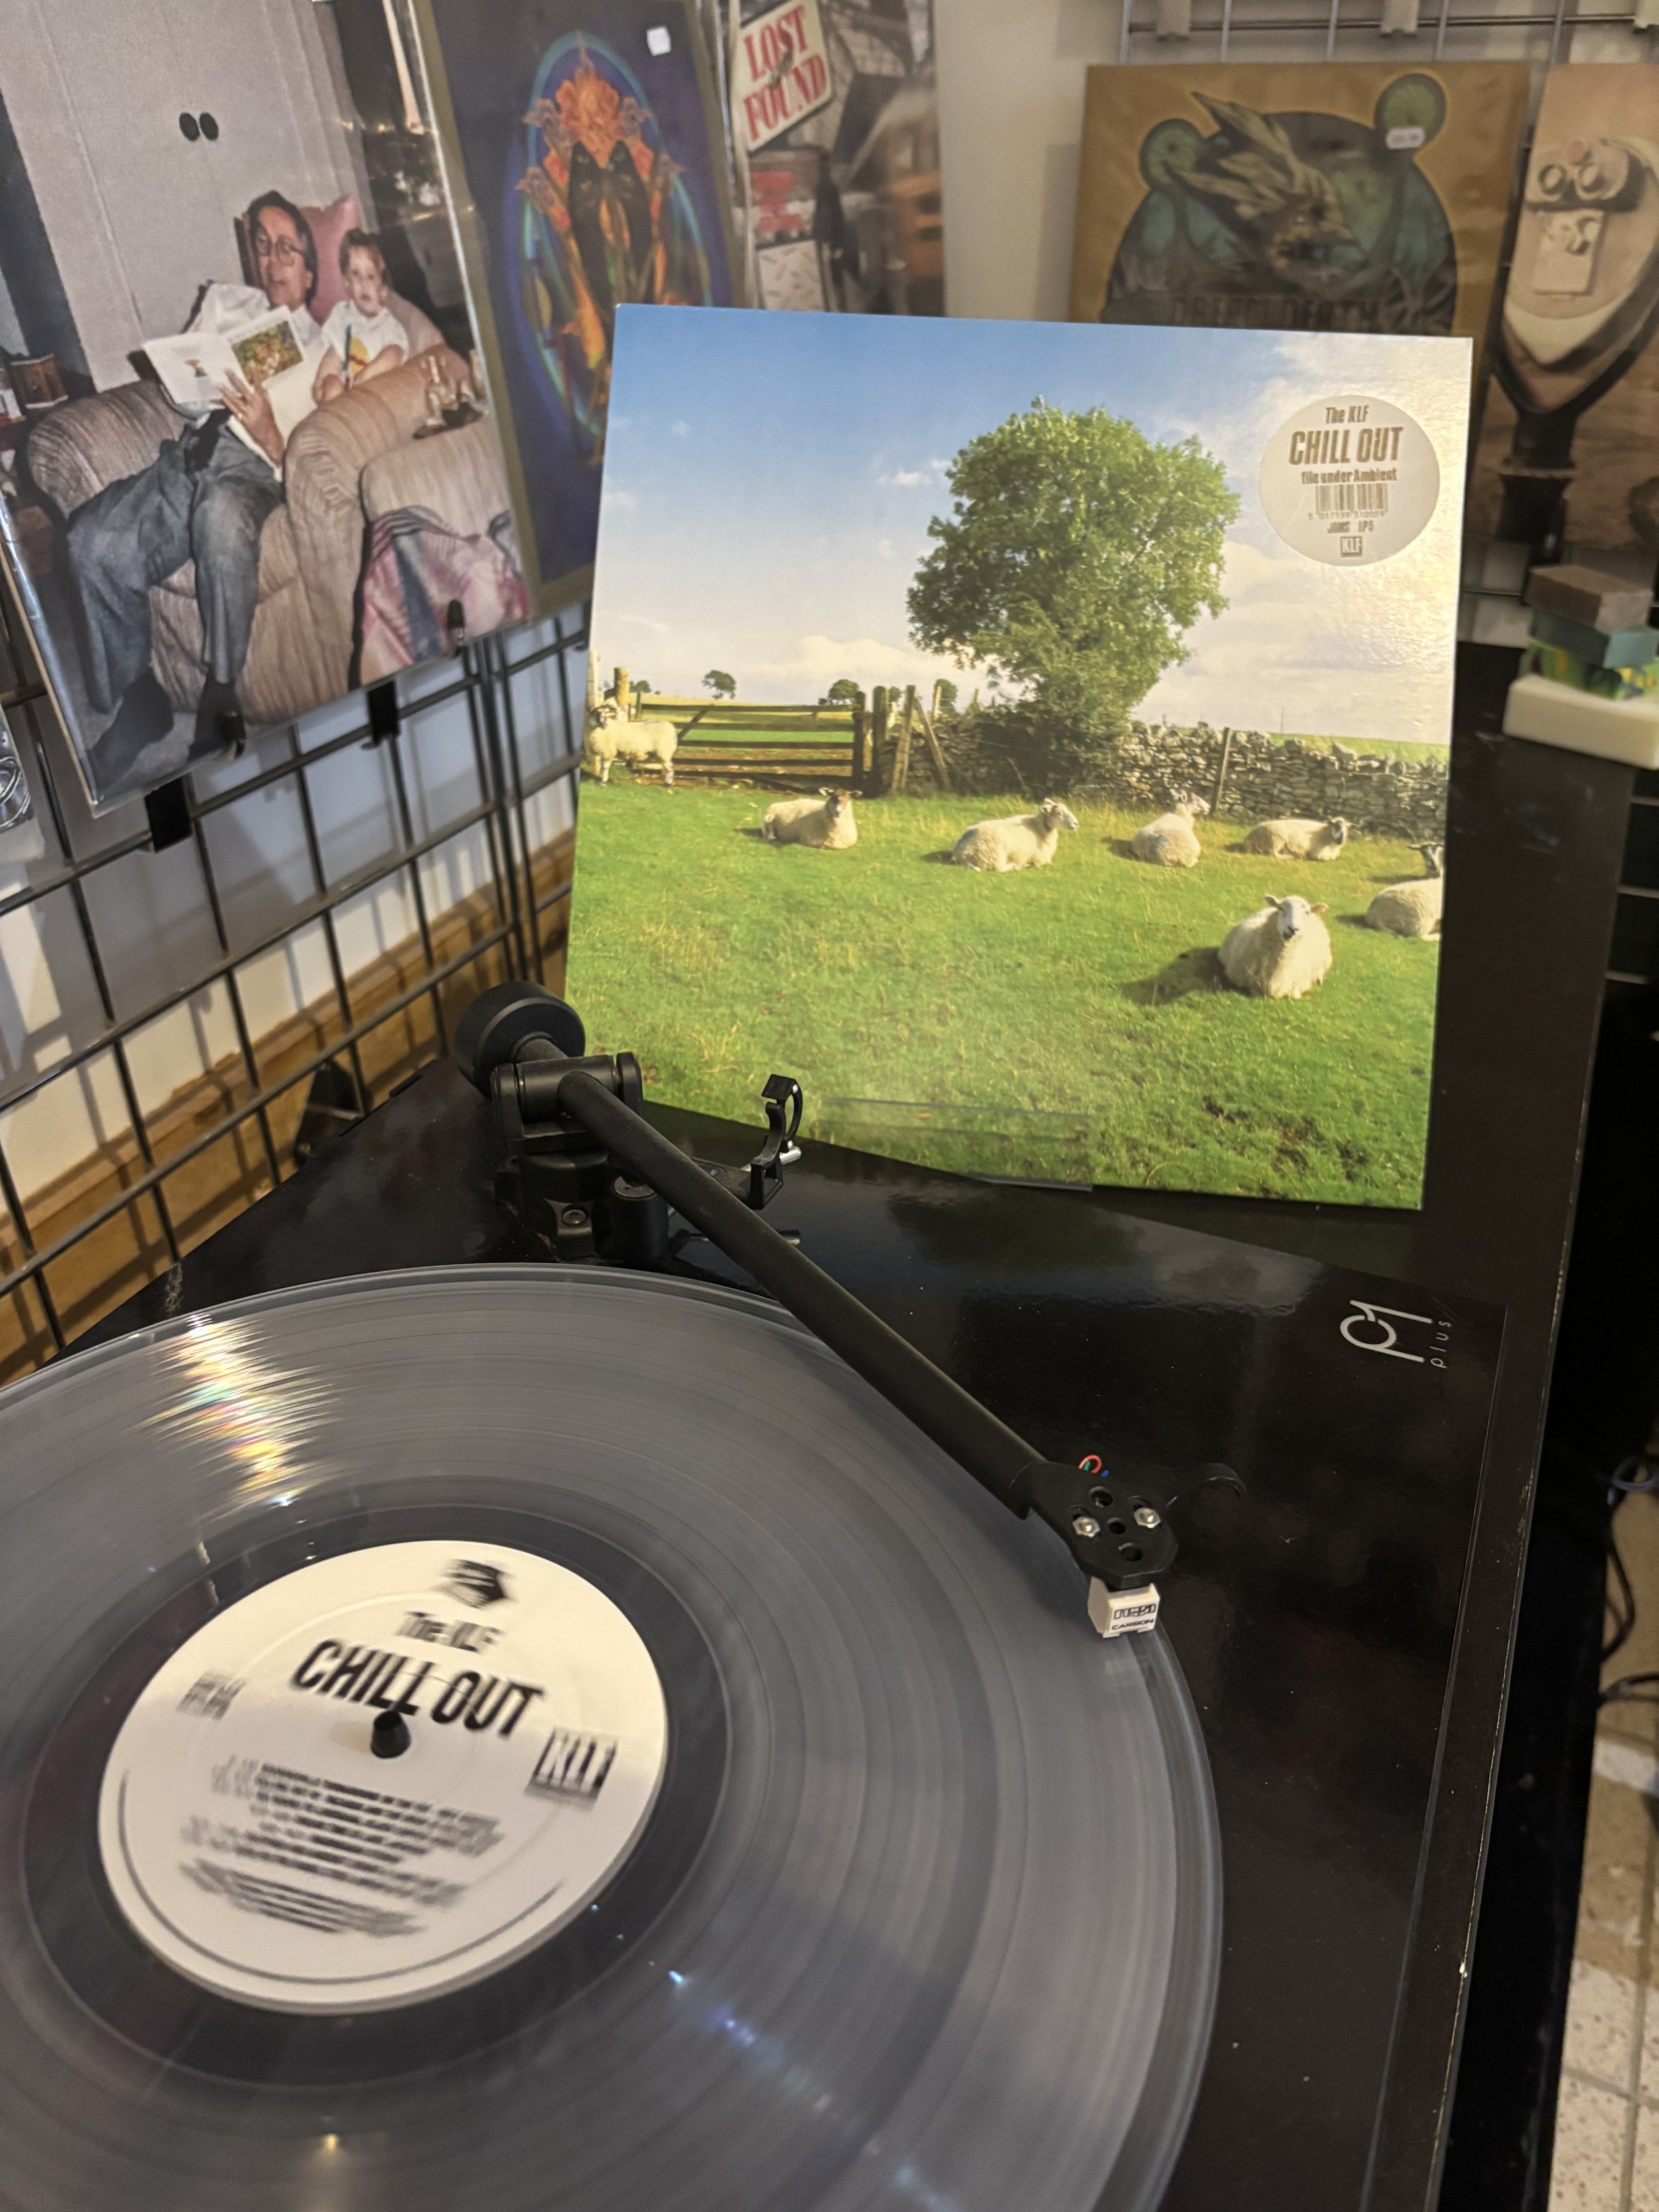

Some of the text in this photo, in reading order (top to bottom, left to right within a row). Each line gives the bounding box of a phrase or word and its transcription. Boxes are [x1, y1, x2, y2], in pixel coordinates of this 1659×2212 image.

[744, 4, 807, 82] LOST
[743, 54, 827, 143] FOUND
[1326, 405, 1369, 423] The KLF
[1289, 427, 1404, 465] CHILL OUT
[1301, 468, 1397, 484] file under Ambient
[1429, 1320, 1451, 1368] plus
[291, 1638, 435, 1717] CHILL
[430, 1669, 545, 1739] OUT
